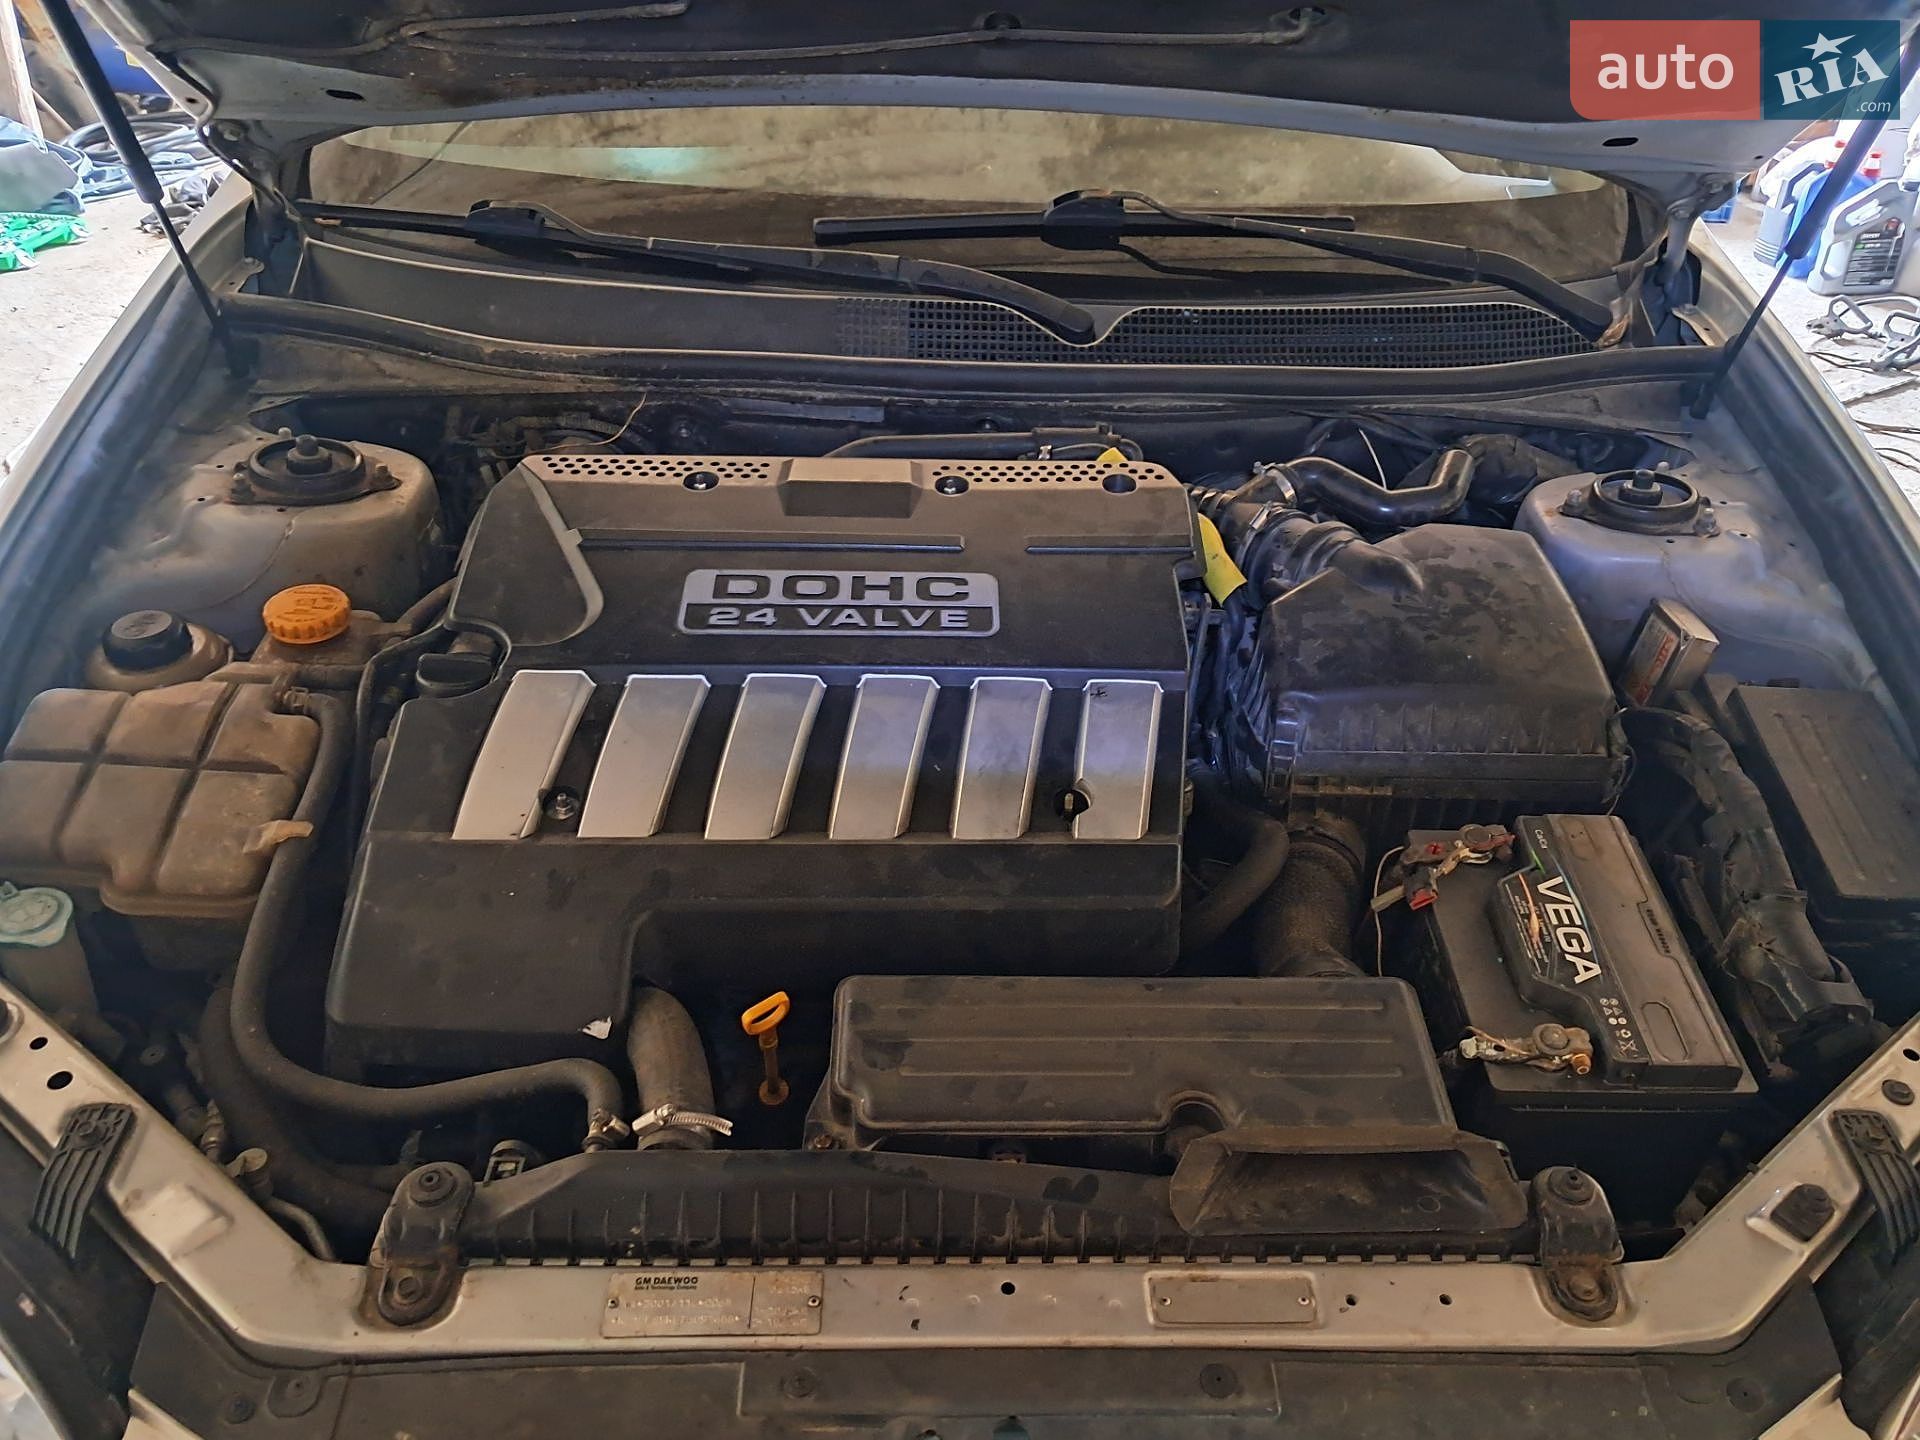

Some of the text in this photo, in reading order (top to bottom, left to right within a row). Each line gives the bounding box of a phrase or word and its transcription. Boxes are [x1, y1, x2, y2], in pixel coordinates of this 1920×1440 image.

[712, 574, 970, 602] DOHC
[708, 606, 970, 628] 24 VALVE
[1537, 876, 1602, 984] VEGA
[635, 1276, 698, 1285] GM DAEWOO
